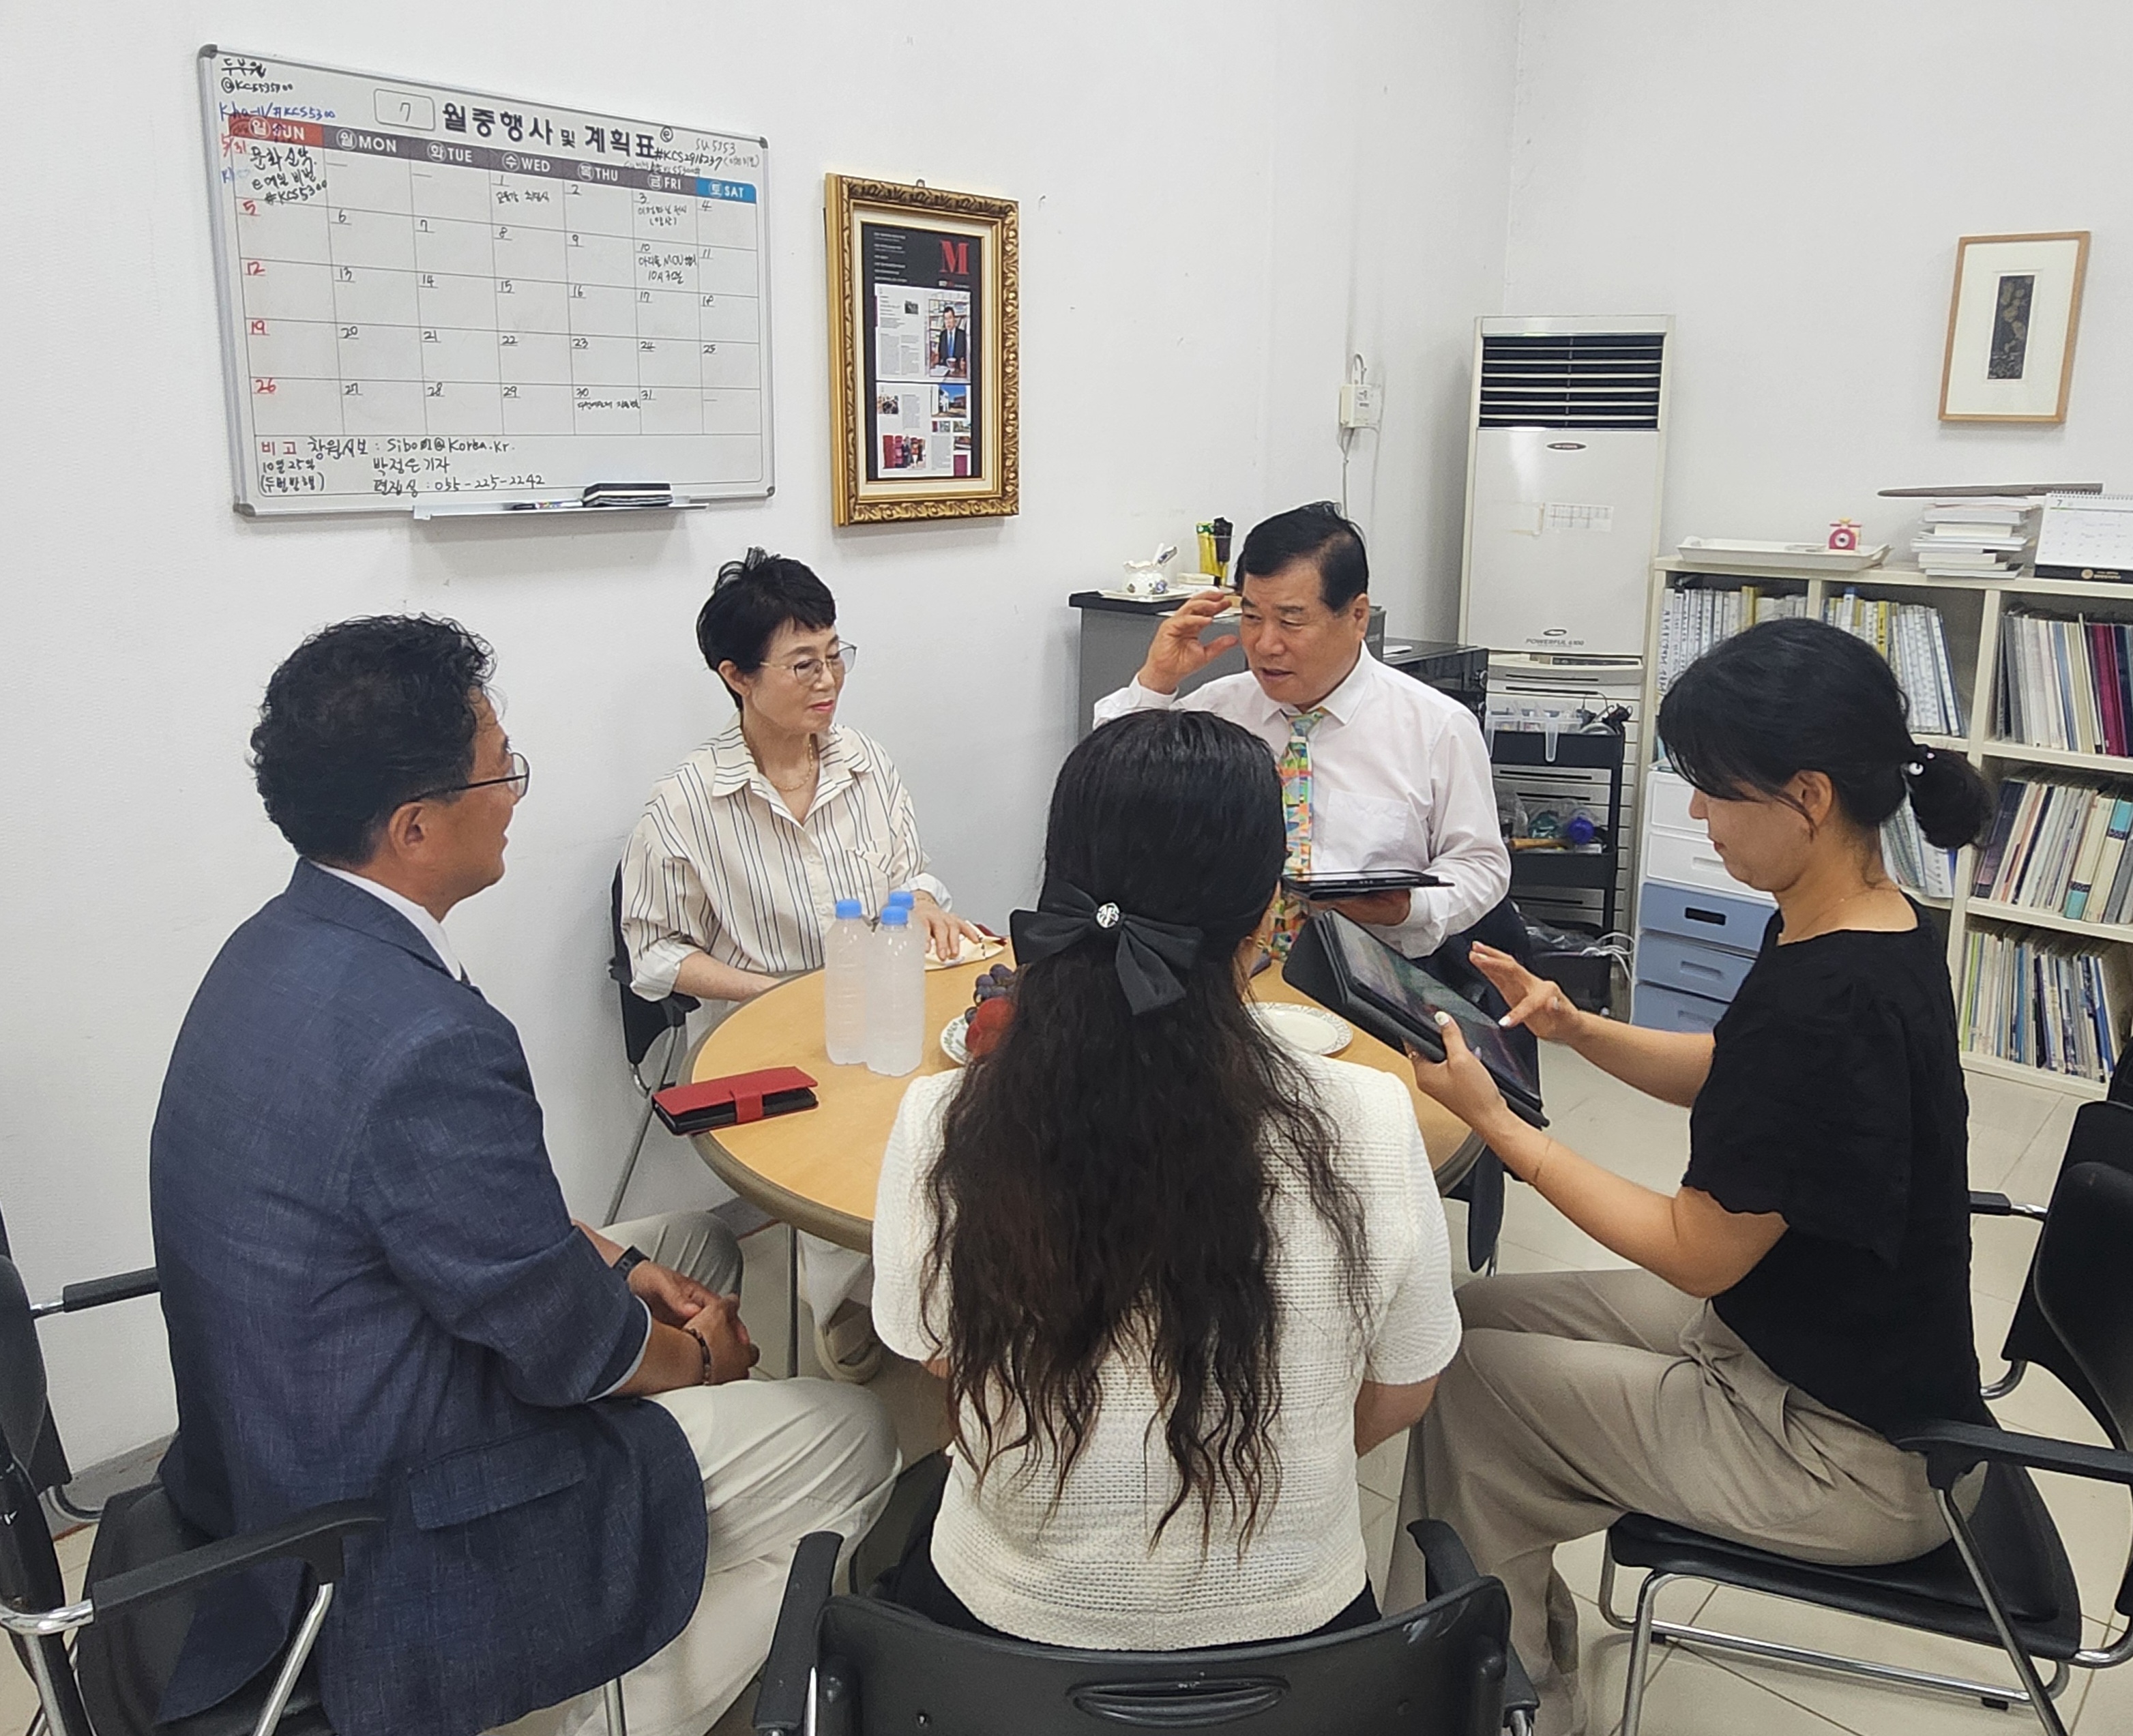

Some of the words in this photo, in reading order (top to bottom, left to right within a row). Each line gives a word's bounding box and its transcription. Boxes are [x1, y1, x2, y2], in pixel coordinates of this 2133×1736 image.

[400, 102, 411, 123] 7
[442, 102, 553, 145] 월중행사
[560, 128, 576, 149] 및
[585, 124, 655, 159] 계획표
[359, 136, 398, 153] MON
[447, 147, 473, 163] TUE
[520, 156, 551, 173] WED
[595, 166, 619, 182] THU
[572, 184, 581, 195] 2
[664, 177, 681, 190] FRI
[639, 192, 647, 204] 3
[724, 186, 744, 198] SAT
[243, 200, 257, 215] 5
[701, 200, 712, 211] 4
[338, 209, 347, 224] 6
[420, 219, 429, 232] 7
[498, 226, 507, 239] 8
[572, 235, 580, 246] 9
[641, 243, 651, 252] 10
[702, 248, 711, 259] 11
[939, 239, 969, 276] M
[247, 261, 266, 276] 12
[339, 267, 353, 282] 13
[422, 274, 435, 288] 14
[500, 280, 513, 293] 15
[573, 284, 583, 297] 16
[639, 291, 650, 302] 17
[250, 320, 265, 335] 19
[341, 326, 359, 339] 20
[424, 330, 438, 342] 21
[501, 335, 518, 345] 22
[573, 338, 589, 349] 23
[640, 341, 656, 351] 24
[703, 344, 716, 354] 25
[255, 379, 276, 394] 26
[345, 383, 359, 395] 27
[427, 383, 443, 397] 28
[503, 385, 518, 397] 29
[576, 387, 589, 398] 30
[641, 389, 653, 400] 31
[2057, 499, 2063, 507] 7
